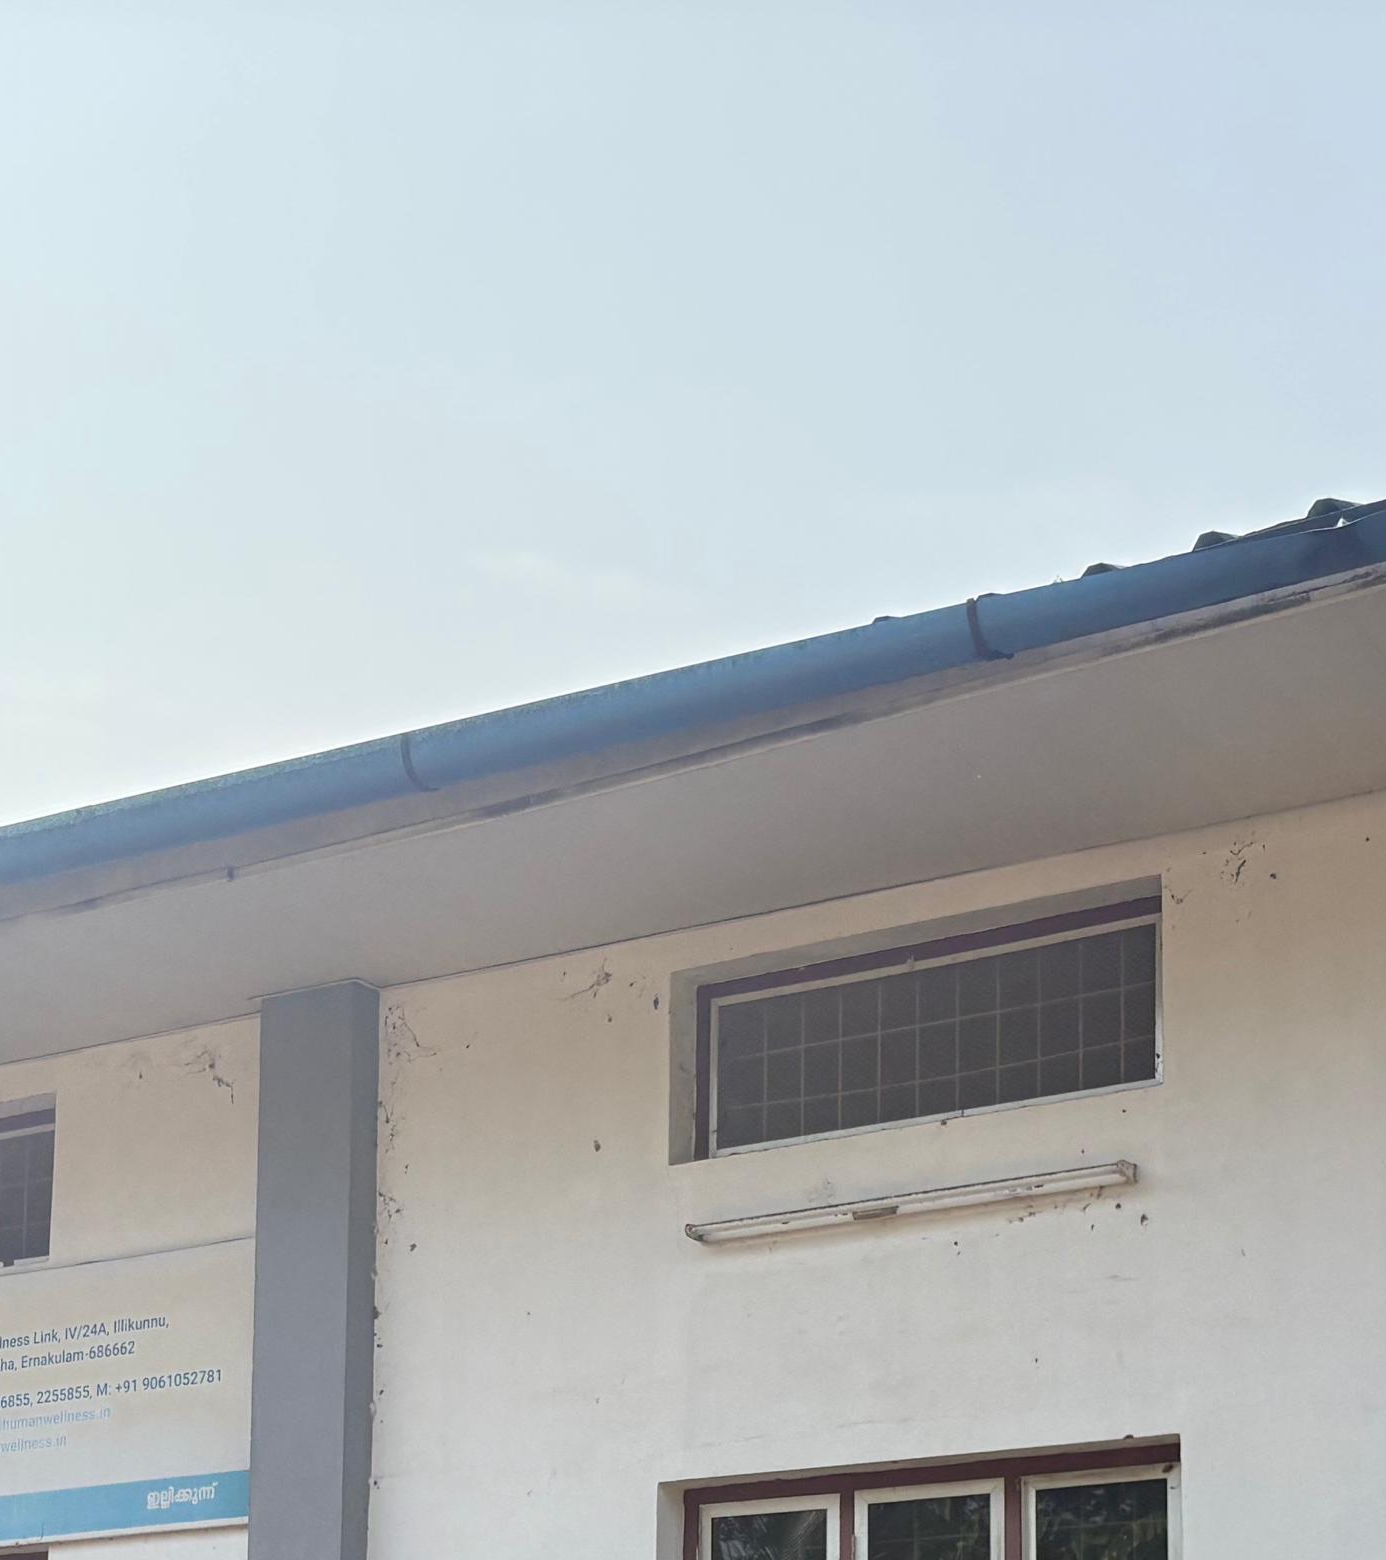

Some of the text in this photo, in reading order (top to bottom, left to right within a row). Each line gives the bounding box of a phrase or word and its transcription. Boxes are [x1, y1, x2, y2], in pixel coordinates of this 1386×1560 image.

[33, 1329, 61, 1344] Link,
[64, 1322, 110, 1341] IV/24A,
[113, 1316, 170, 1334] Illikunnu,
[21, 1340, 136, 1369] Ernakulam-686662
[36, 1385, 93, 1405] 2255855,
[96, 1383, 112, 1397] M:
[115, 1379, 138, 1393] +91
[142, 1369, 222, 1391] 9061052781
